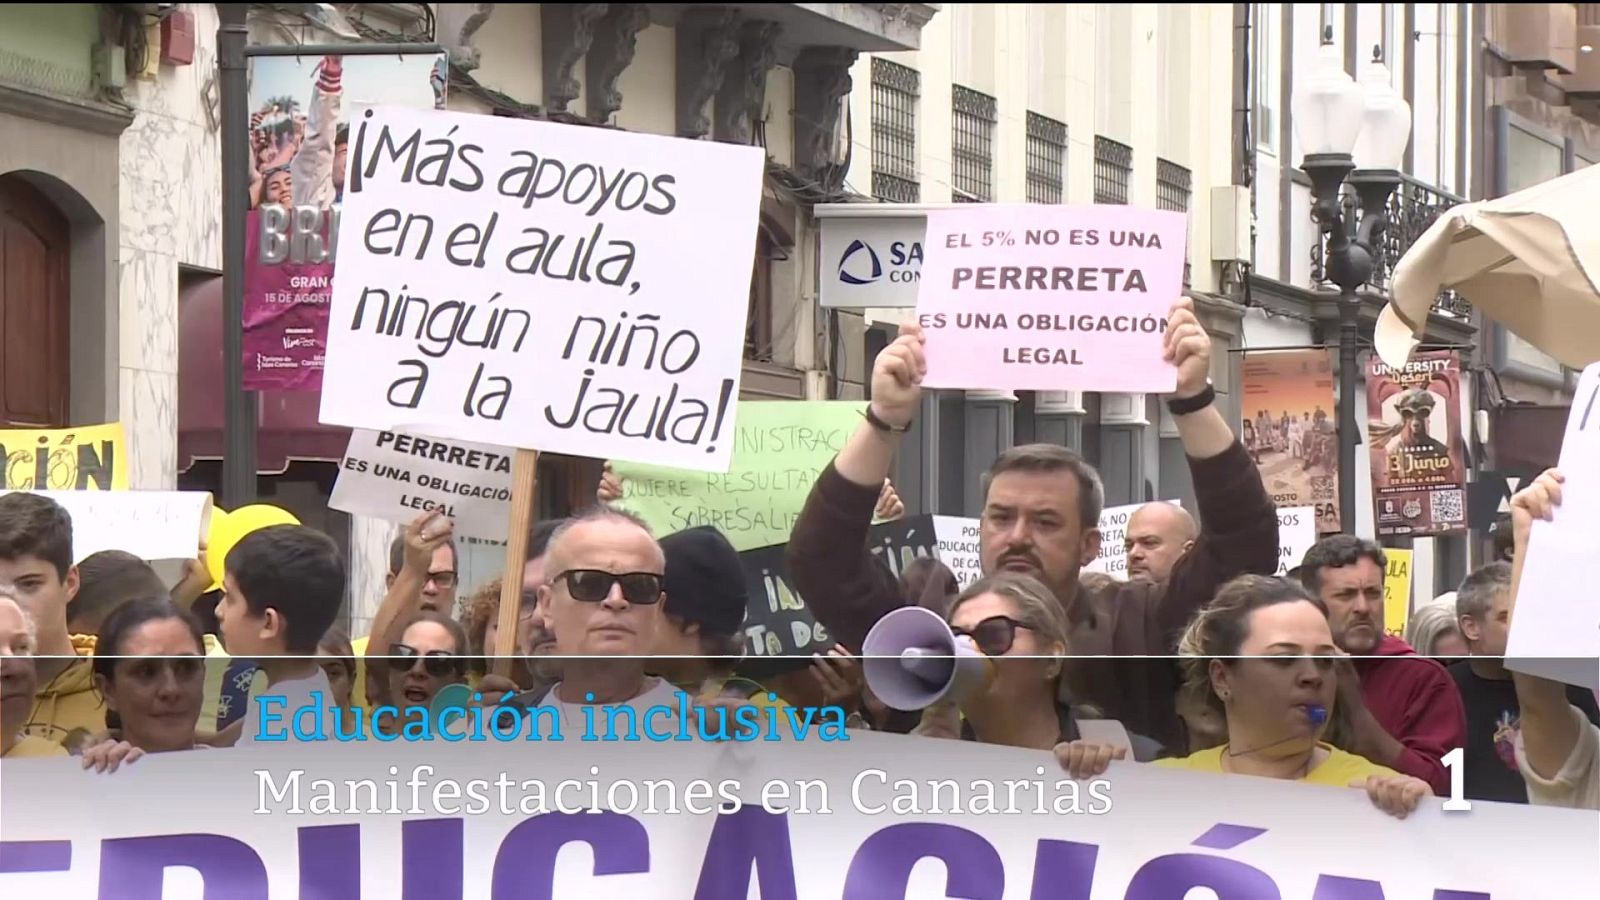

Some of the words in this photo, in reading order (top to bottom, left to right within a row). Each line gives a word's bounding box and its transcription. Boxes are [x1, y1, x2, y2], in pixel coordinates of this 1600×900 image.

[497, 150, 677, 216] apoyos
[363, 208, 434, 260] en
[445, 211, 499, 268] el
[505, 222, 641, 295] aula,
[945, 233, 972, 249] EL
[982, 231, 1015, 247] 5%
[1025, 229, 1060, 246] NO
[1069, 229, 1100, 246] ES
[1109, 230, 1162, 250] UNA
[291, 277, 327, 288] GRAN
[951, 266, 1148, 293] PERRRETA
[351, 284, 531, 358] ningún
[561, 310, 701, 374] niño
[919, 313, 947, 329] ES
[956, 313, 1008, 330] UNA
[1003, 347, 1084, 365] LEGAL
[1372, 359, 1451, 375] UNERSITY
[386, 359, 429, 409] a
[463, 362, 512, 421] la
[375, 430, 511, 474] PERRRETA
[345, 457, 368, 473] ES
[374, 463, 411, 483] UNA
[399, 494, 456, 518] LEGAL
[1110, 513, 1127, 525] NO
[953, 558, 963, 568] DE
